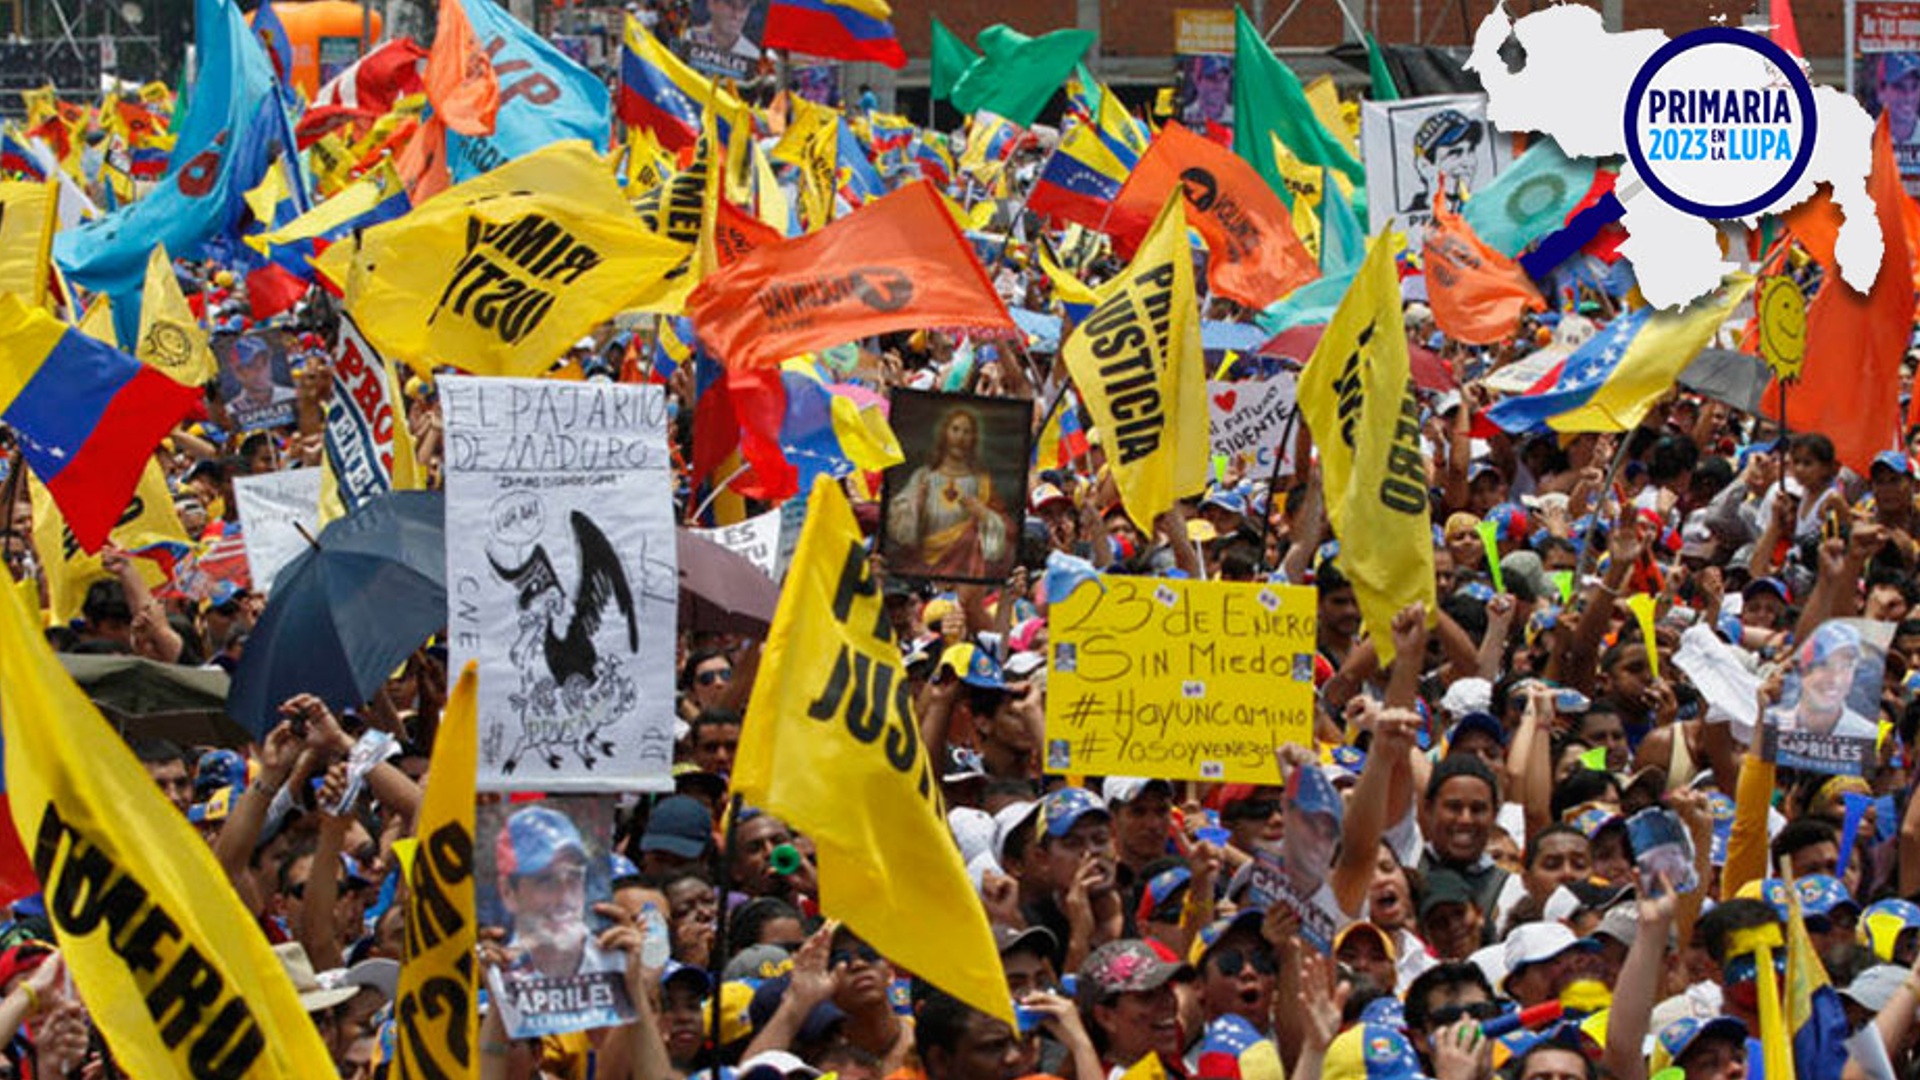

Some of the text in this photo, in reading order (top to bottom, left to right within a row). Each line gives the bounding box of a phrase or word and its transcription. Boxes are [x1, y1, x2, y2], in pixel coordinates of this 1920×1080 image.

[448, 386, 498, 427] EL
[1213, 400, 1289, 456] SIDENTE
[450, 434, 648, 471] DE MADURO
[457, 576, 480, 652] CNE
[1062, 580, 1154, 634] 23
[1776, 734, 1863, 762] CAPRILES
